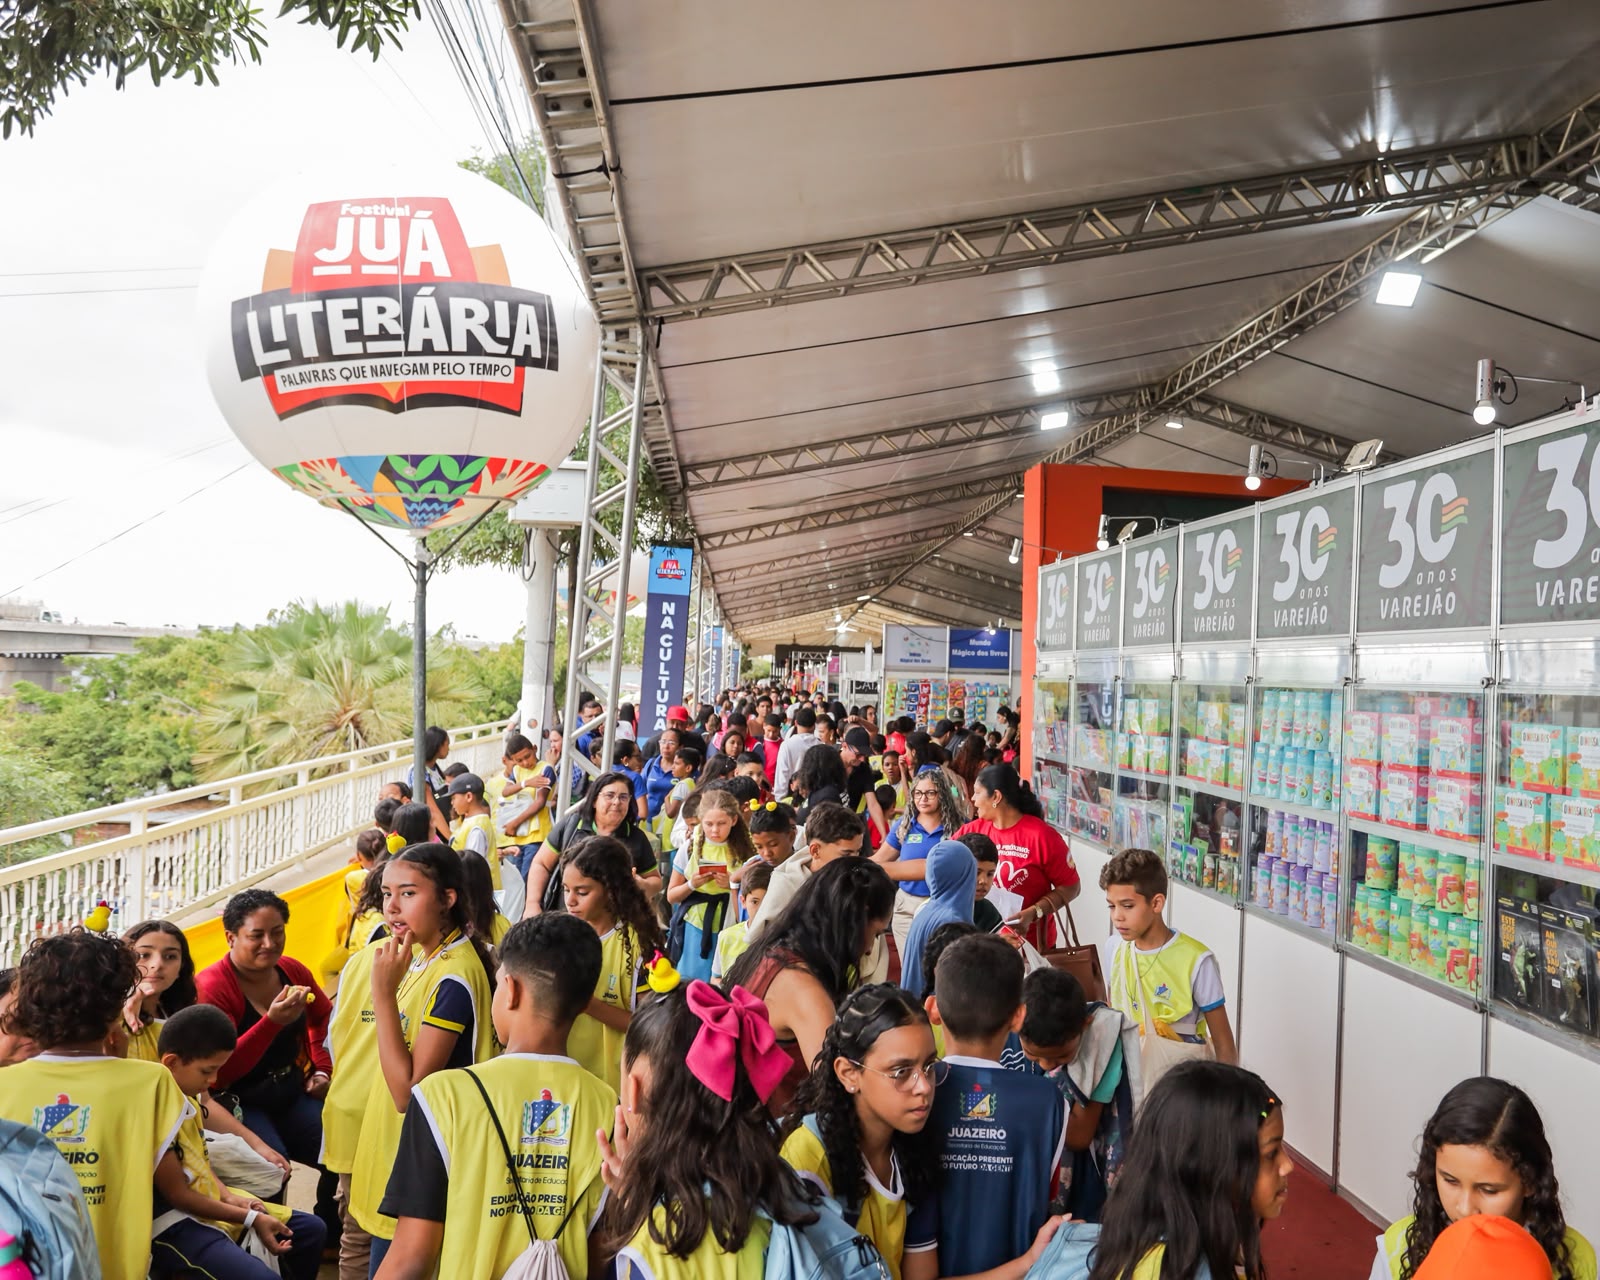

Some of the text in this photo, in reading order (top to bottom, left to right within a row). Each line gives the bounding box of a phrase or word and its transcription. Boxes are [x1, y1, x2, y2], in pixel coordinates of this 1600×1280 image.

[341, 203, 410, 217] Festival
[313, 210, 452, 277] JUÁ
[246, 287, 542, 367] LITERÁRIA
[281, 362, 512, 387] PALAVRAS QUE NAVEGAM PELO TEMPO
[1533, 433, 1600, 569] 3
[1535, 576, 1600, 607] VARE
[1379, 587, 1456, 620] VAREJÃO
[1273, 602, 1328, 627] VAREJÃO
[1133, 619, 1165, 638] VAREJÃO
[1193, 612, 1235, 633] VAREJÃO
[969, 639, 991, 647] Mundo
[951, 649, 1008, 657] Mágico dos livros
[653, 601, 675, 731] NA CULTURA
[947, 1127, 1007, 1140] JUAZEIRO
[980, 1143, 1007, 1151] Educação
[507, 1154, 568, 1169] JUAZEIR
[941, 1153, 1014, 1164] DUCAÇÃO PRESENTE
[949, 1162, 978, 1170] FUTURO
[542, 1177, 567, 1185] Educa
[490, 1192, 537, 1206] EDUCAÃO
[489, 1207, 505, 1218] NO
